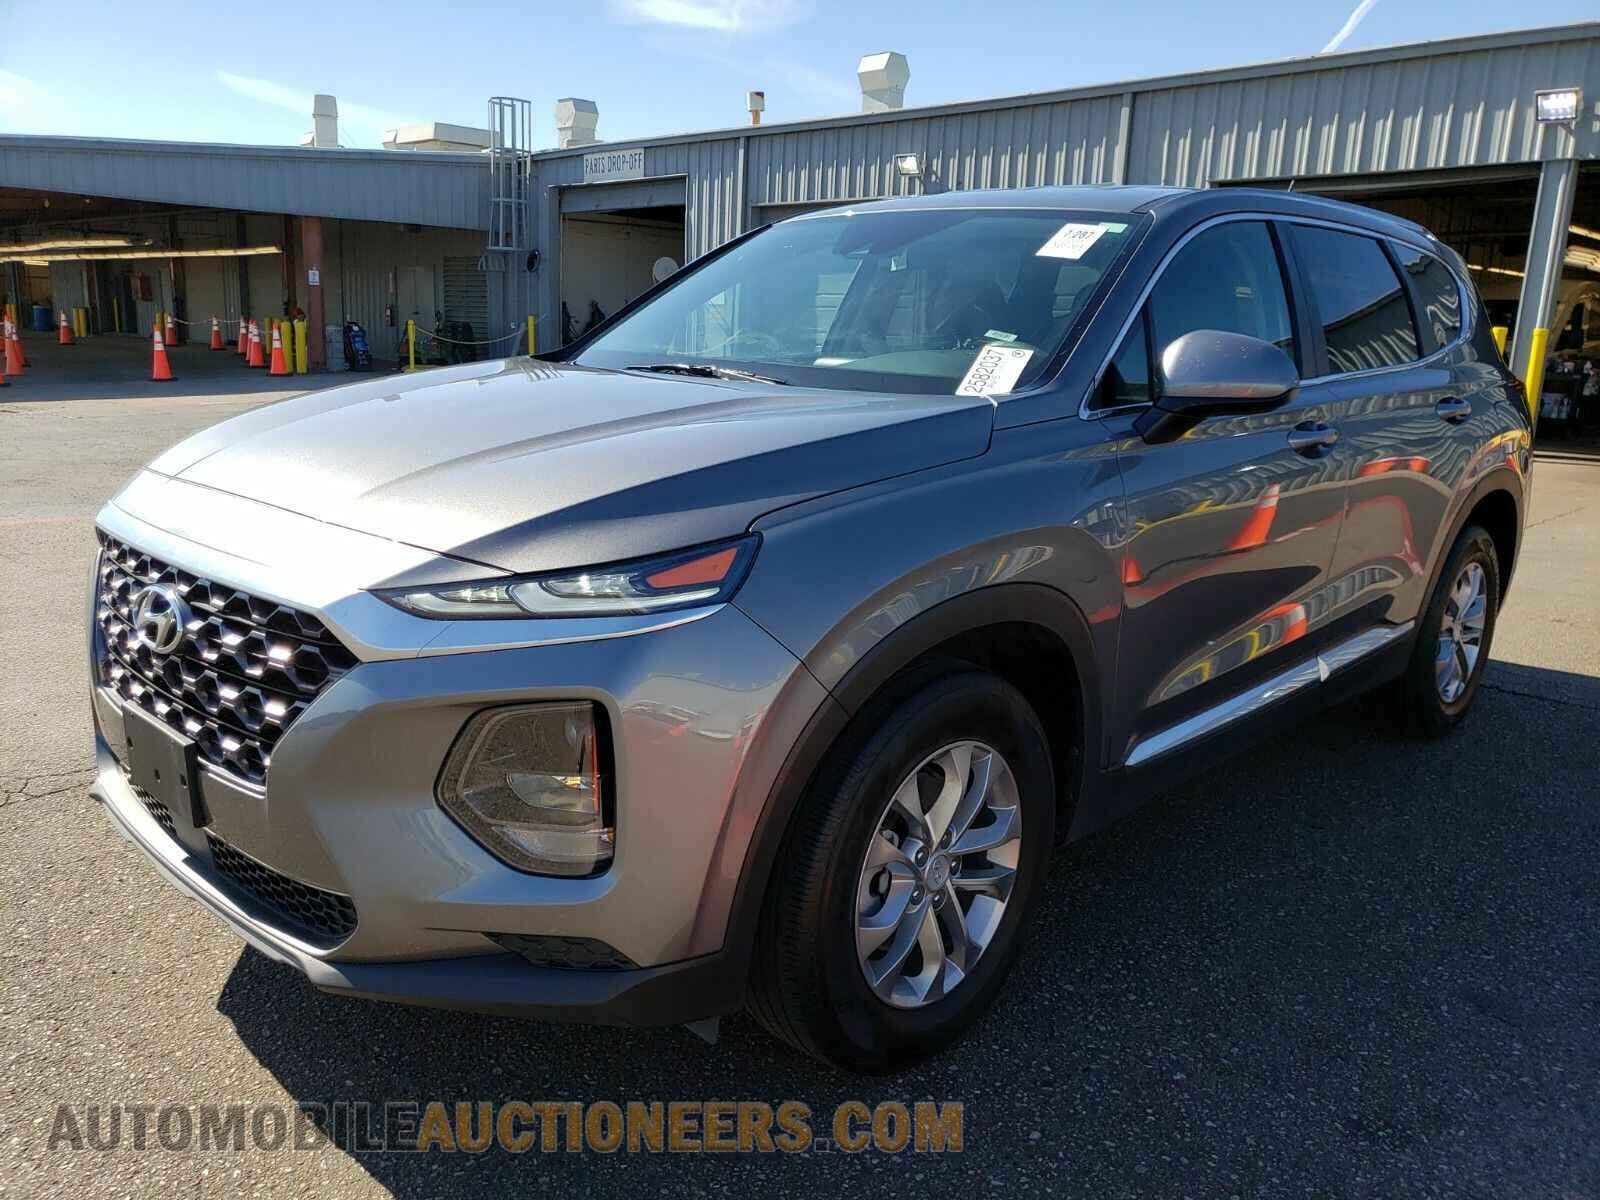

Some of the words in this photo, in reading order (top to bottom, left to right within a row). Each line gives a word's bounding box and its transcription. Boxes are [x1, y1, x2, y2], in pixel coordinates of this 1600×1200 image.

[585, 156, 605, 174] PARTS
[607, 152, 643, 171] DROP-OFF
[963, 349, 1005, 393] 2582037
